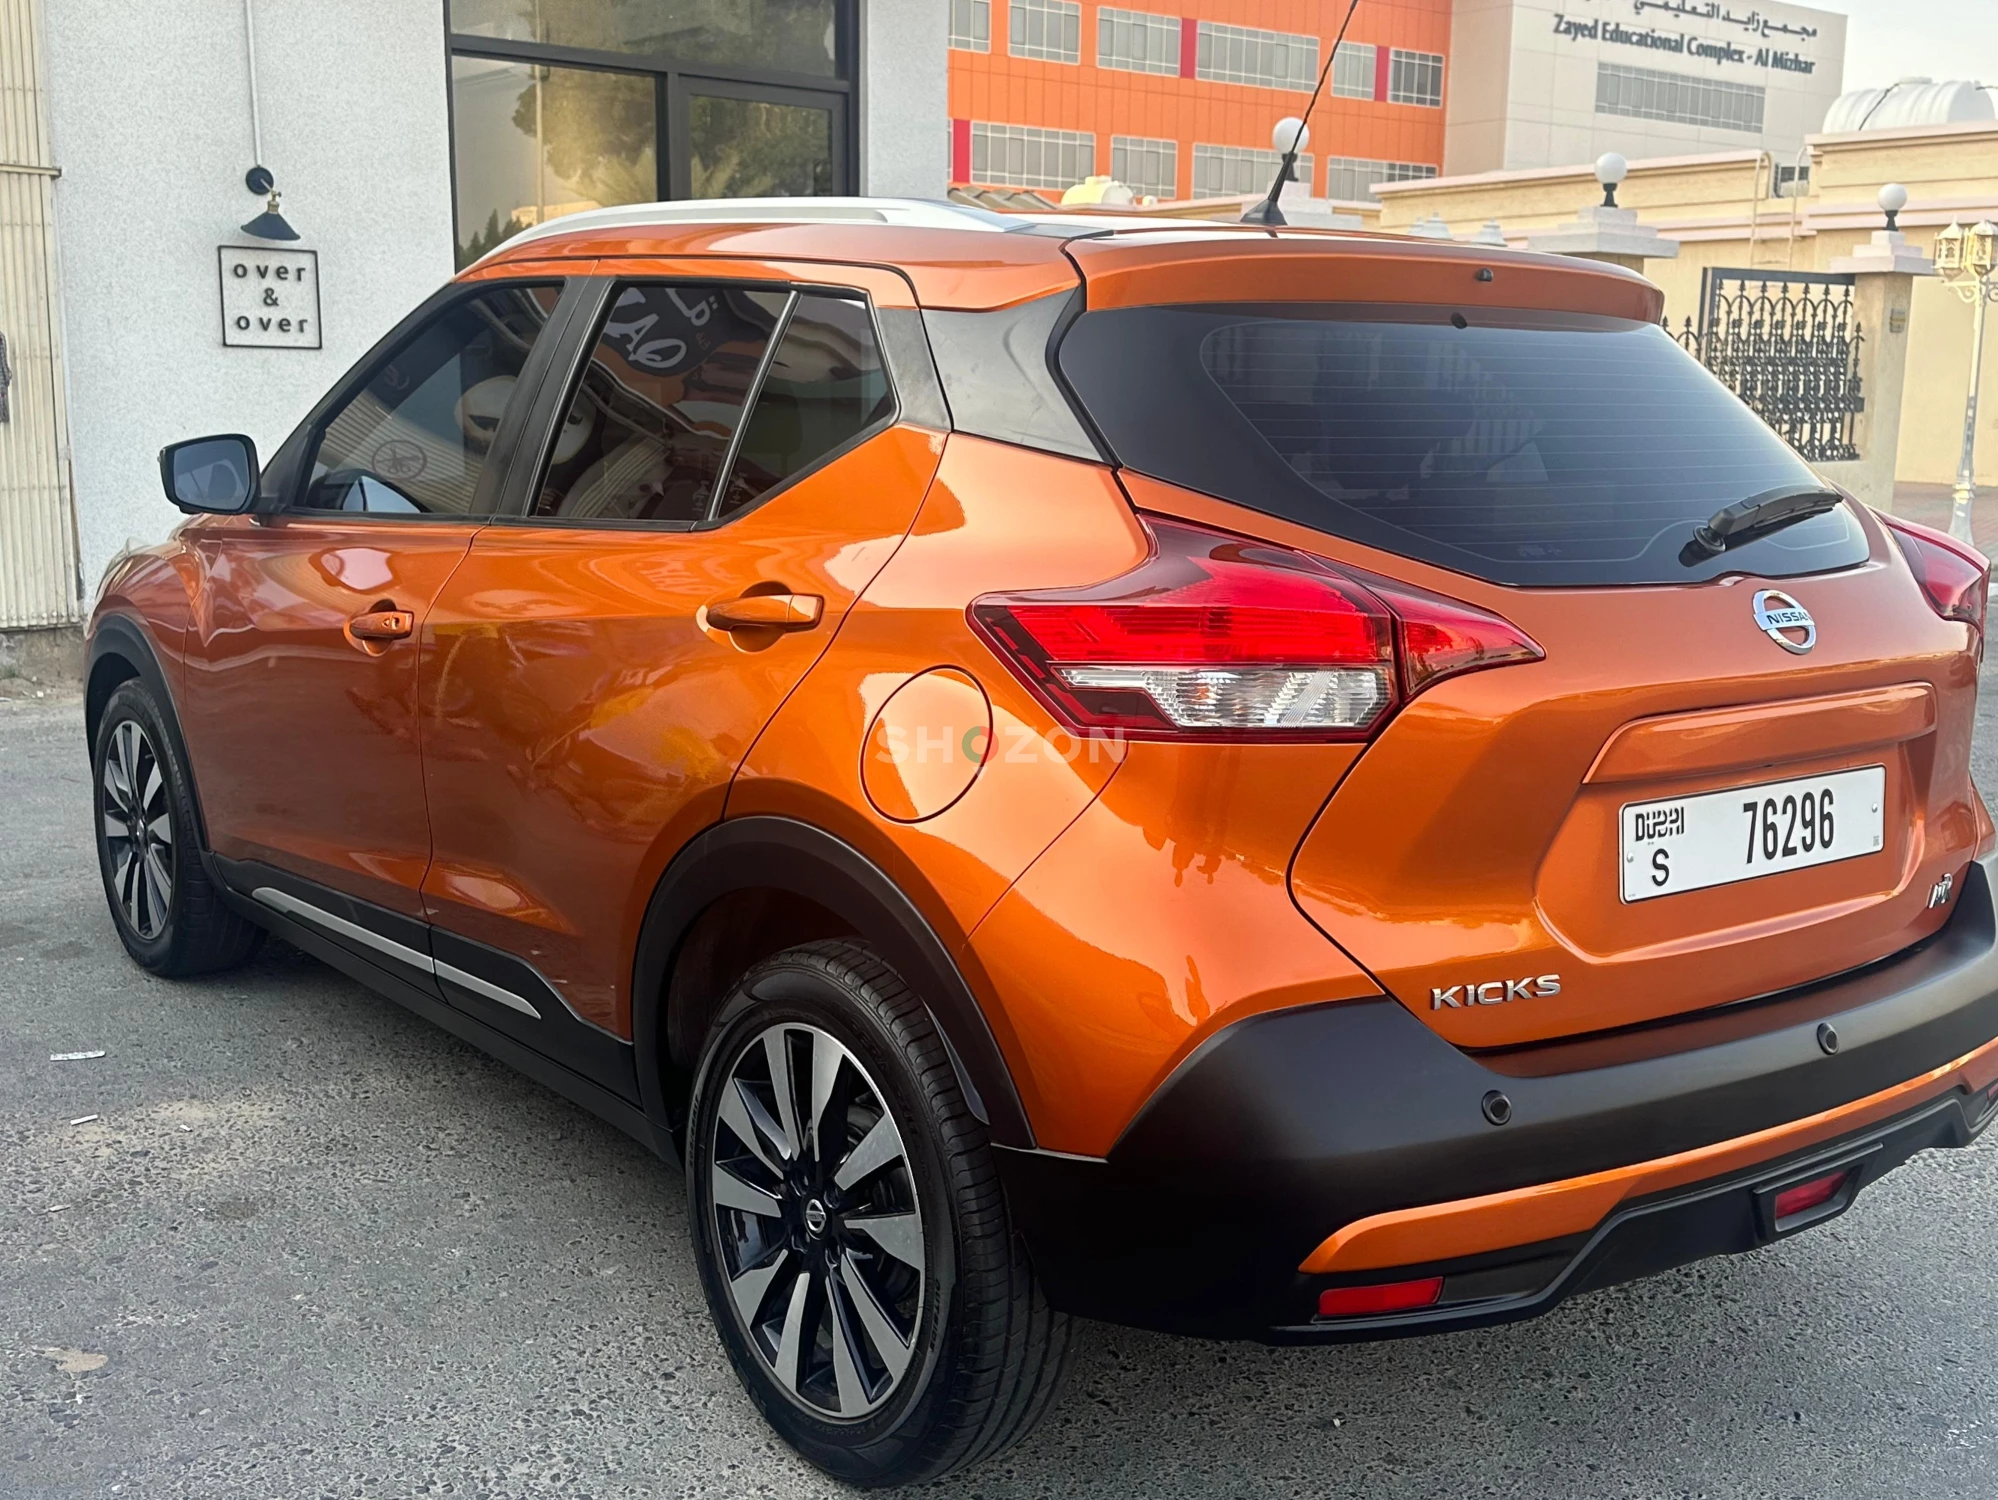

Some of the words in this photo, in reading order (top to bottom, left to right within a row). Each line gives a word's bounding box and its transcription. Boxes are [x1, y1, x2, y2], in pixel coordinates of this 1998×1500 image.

[1722, 10, 1760, 32] زايد
[1762, 19, 1817, 41] مجمع
[1553, 13, 1598, 41] Zayed
[1601, 21, 1684, 53] Educational
[1687, 36, 1745, 65] Complex
[1754, 48, 1770, 67] Al
[1771, 50, 1815, 74] Mizhar
[233, 263, 307, 282] over
[263, 287, 280, 307] &
[236, 315, 308, 333] over
[1742, 788, 1835, 865] 76296
[1651, 848, 1670, 887] S
[1431, 973, 1562, 1011] KICKS
